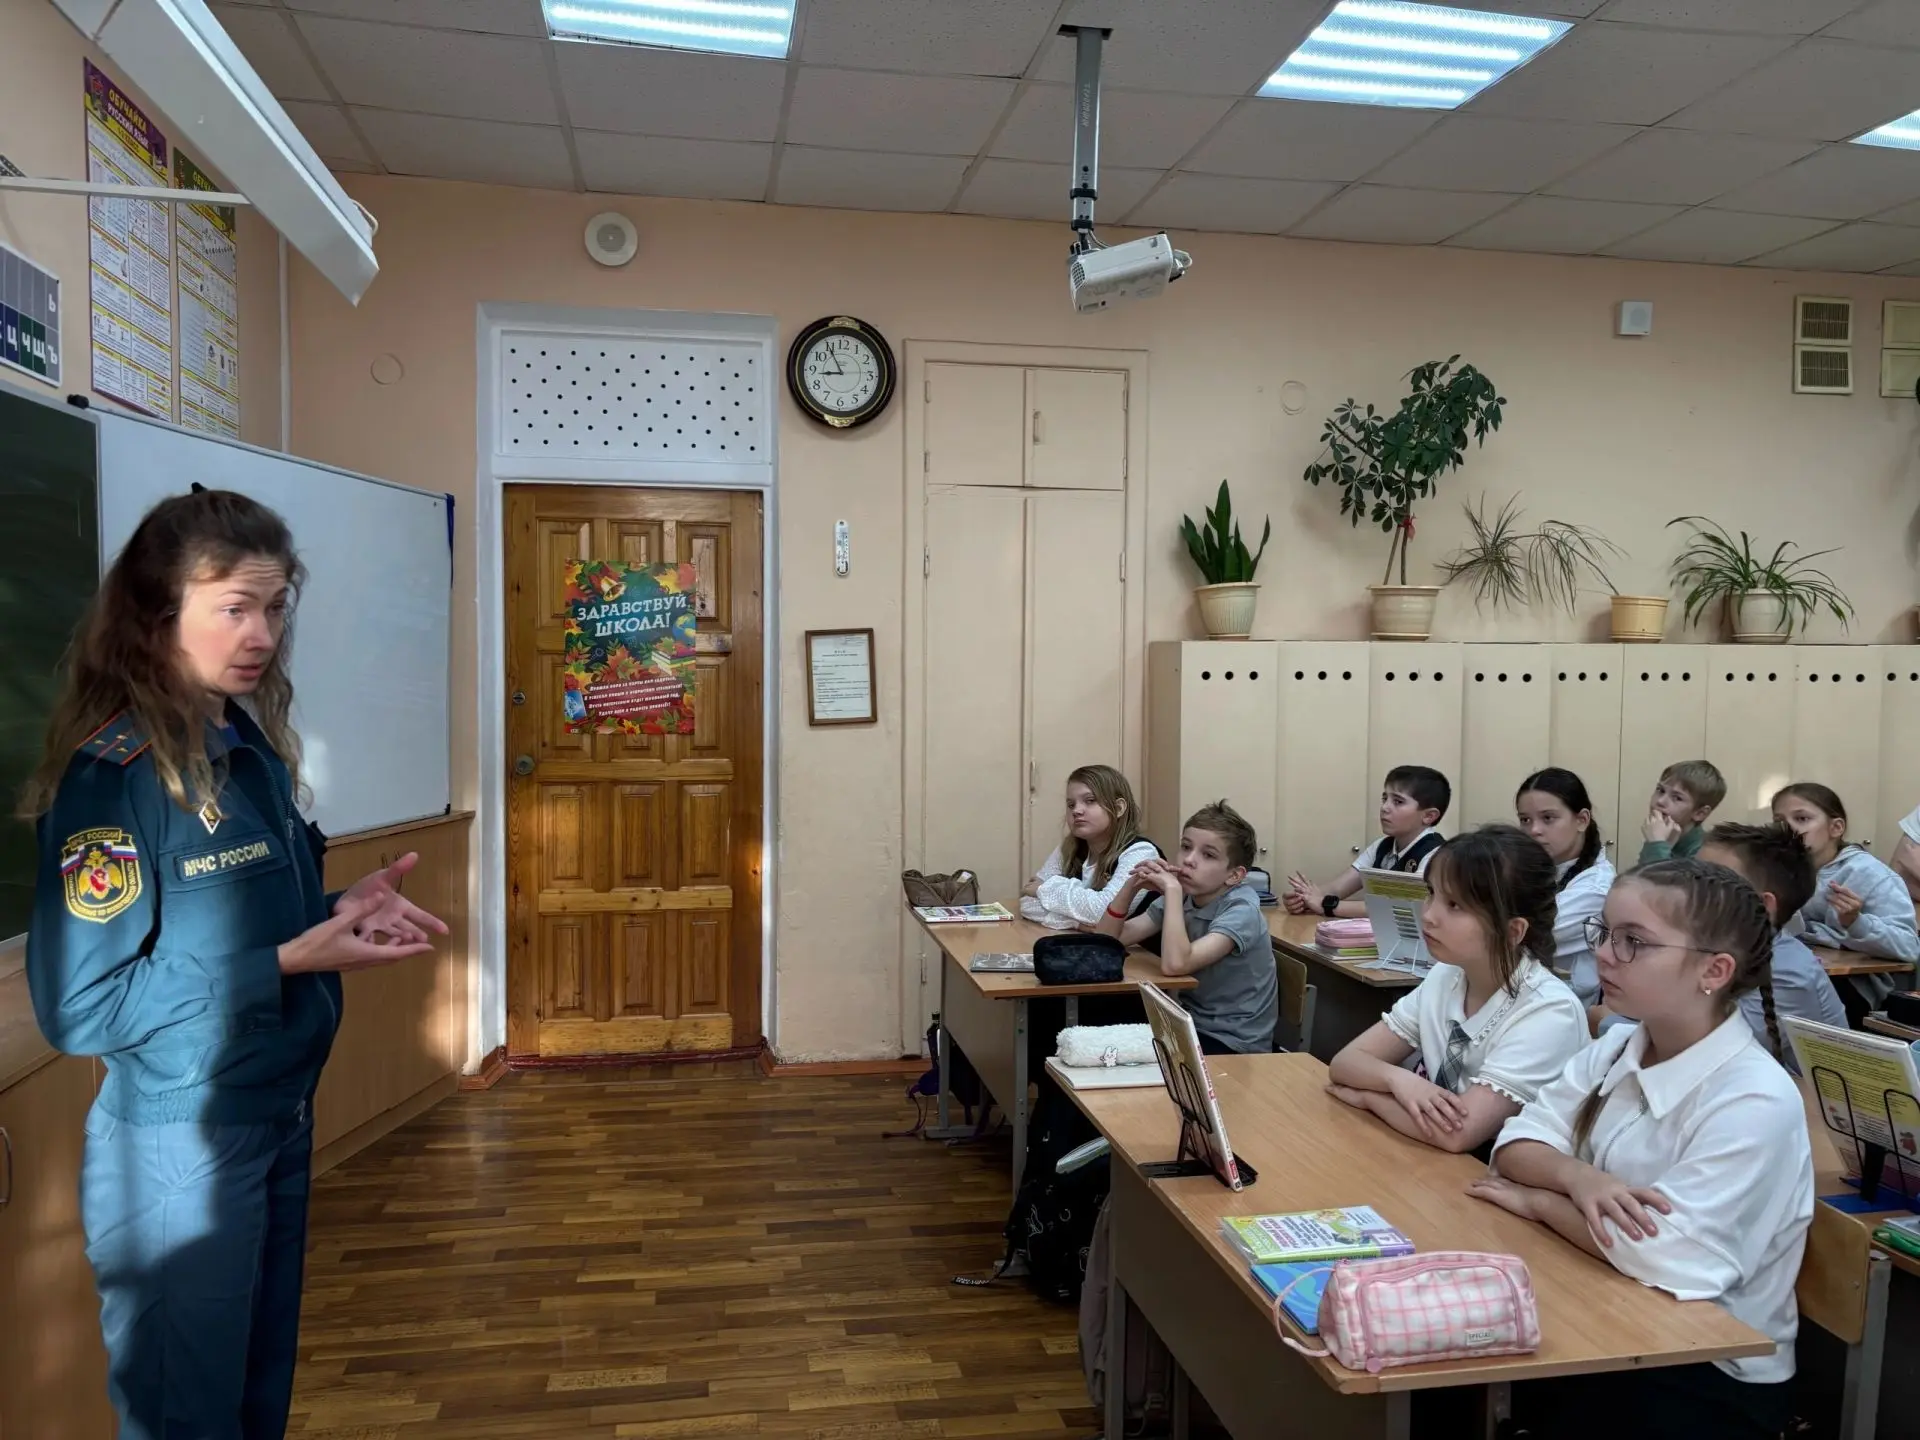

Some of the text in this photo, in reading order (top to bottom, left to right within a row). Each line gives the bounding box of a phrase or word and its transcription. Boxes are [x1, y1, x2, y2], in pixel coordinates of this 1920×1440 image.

[108, 88, 147, 135] ОБУЧАЙКА
[826, 342, 834, 351] 11
[838, 340, 849, 350] 12
[855, 345, 858, 354] 1
[815, 352, 826, 361] 10
[862, 355, 869, 364] 2
[809, 365, 817, 375] 9
[867, 370, 874, 381] 3
[813, 380, 820, 390] 8
[860, 385, 869, 394] 4
[823, 391, 830, 401] 7
[851, 394, 859, 404] 5
[837, 397, 844, 406] 6
[595, 612, 671, 637] ШКОЛА!
[183, 841, 270, 878] МЧС РОССИИ
